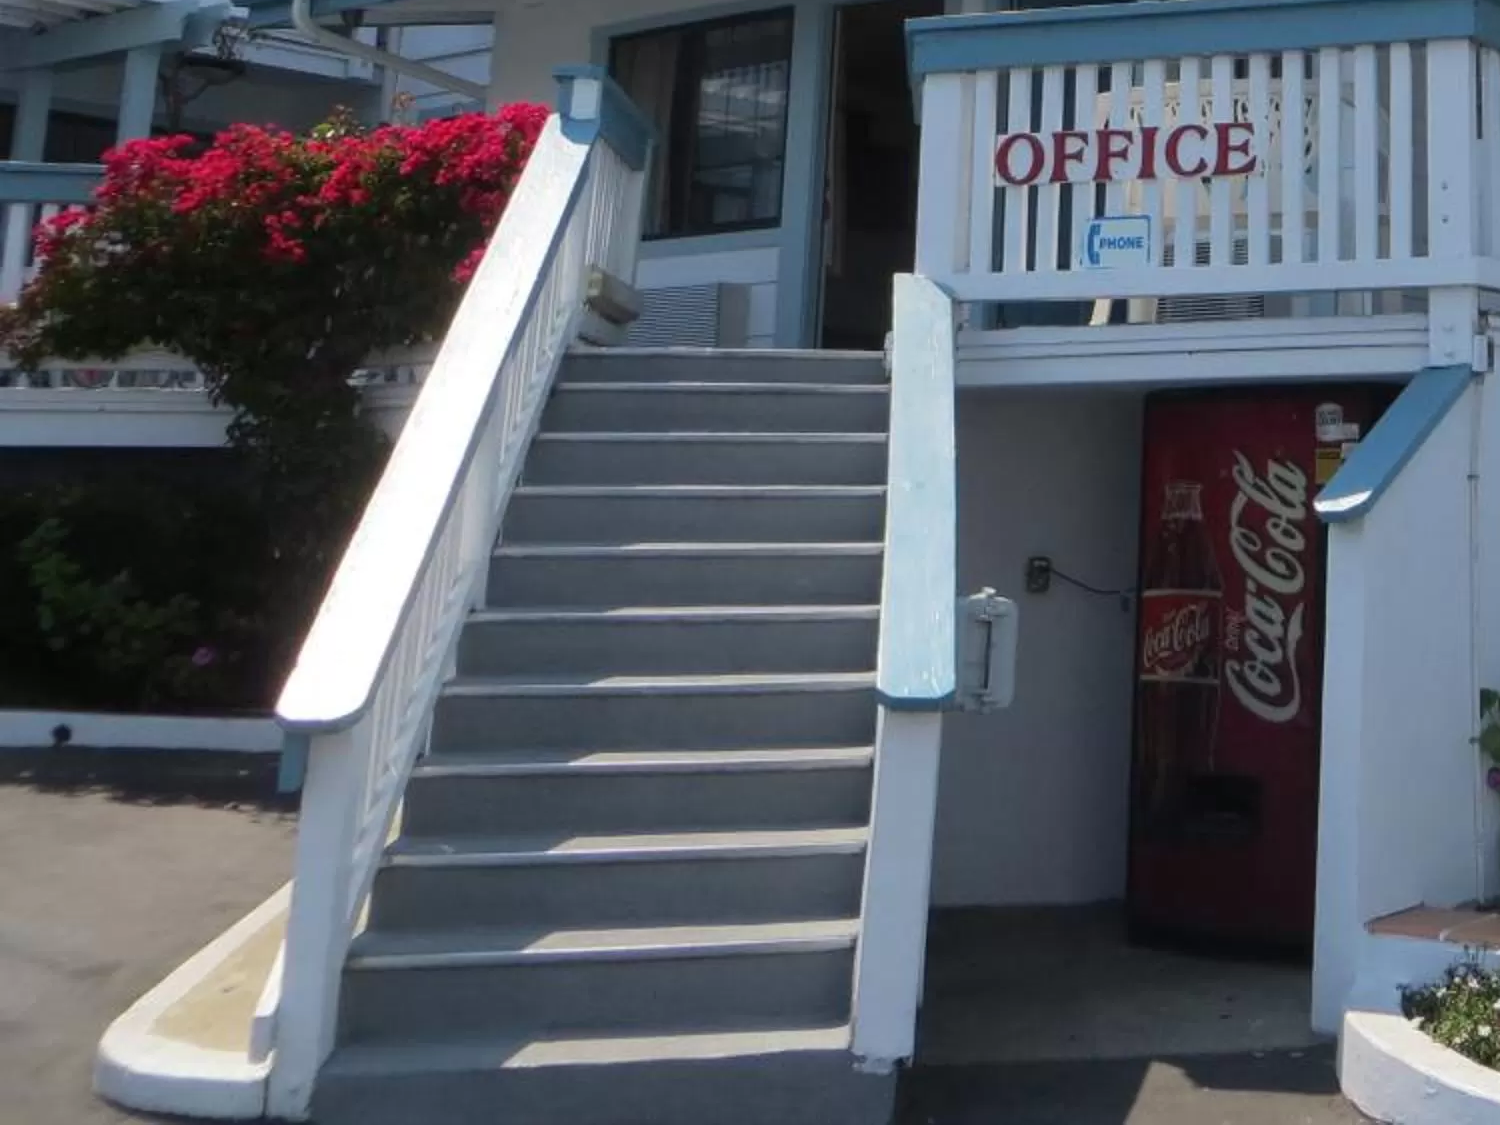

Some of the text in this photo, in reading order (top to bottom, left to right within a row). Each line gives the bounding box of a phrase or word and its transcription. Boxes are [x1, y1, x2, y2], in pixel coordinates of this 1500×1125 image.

[994, 122, 1257, 186] OFFICE
[1099, 235, 1145, 251] PHONE
[1224, 450, 1308, 723] Coca-Cola
